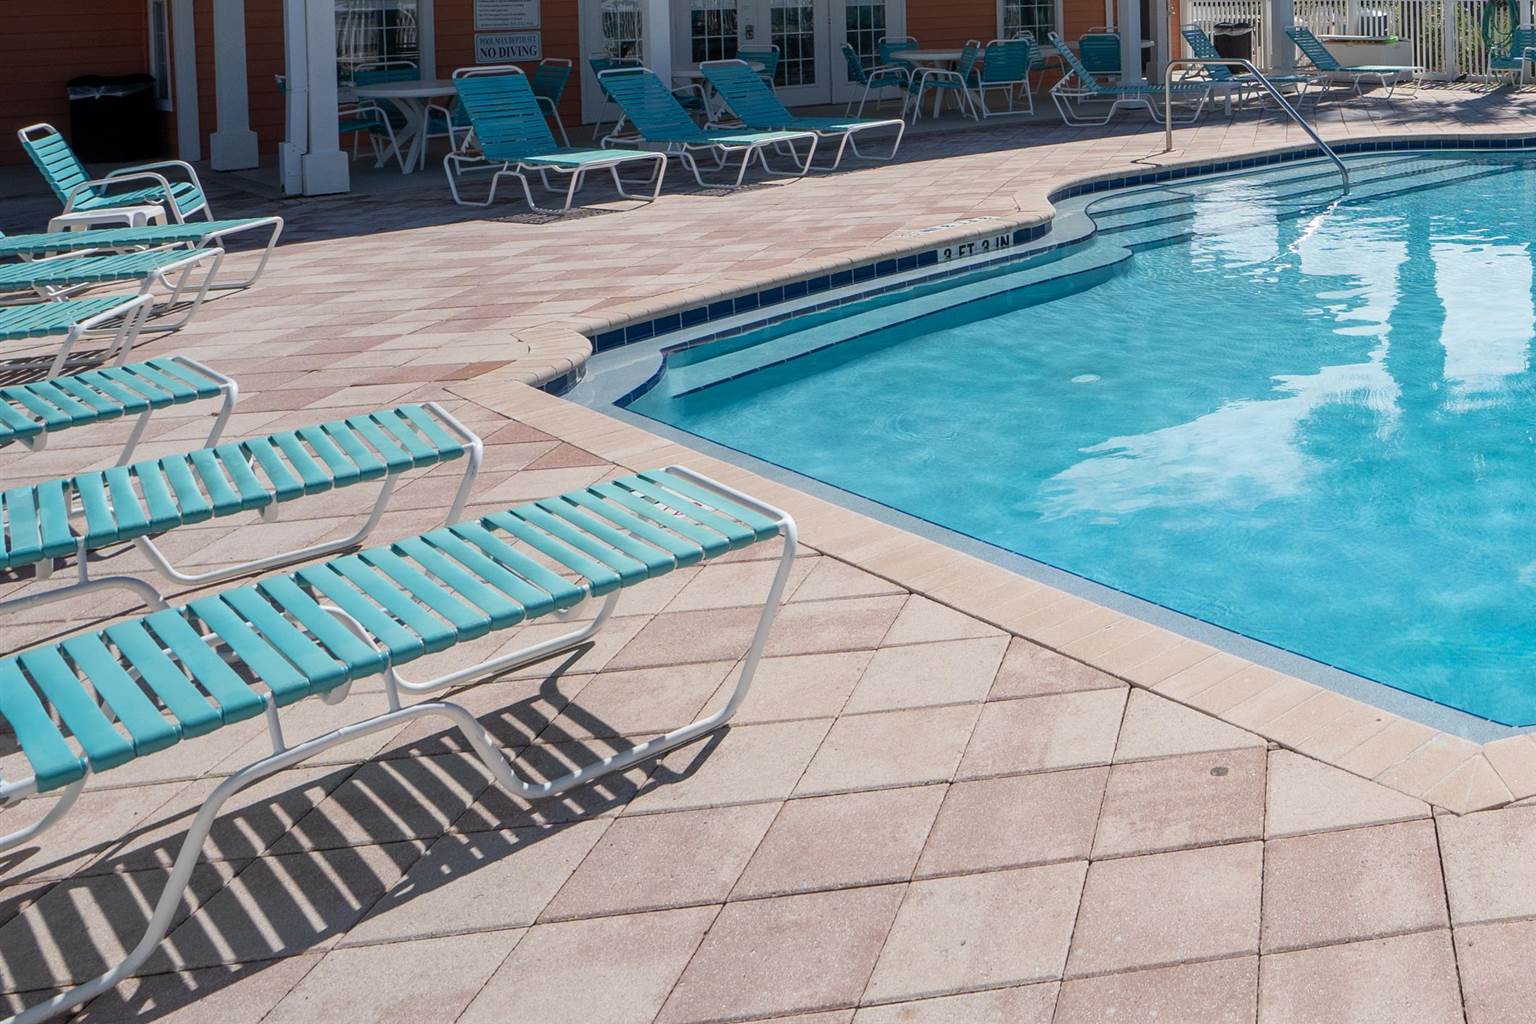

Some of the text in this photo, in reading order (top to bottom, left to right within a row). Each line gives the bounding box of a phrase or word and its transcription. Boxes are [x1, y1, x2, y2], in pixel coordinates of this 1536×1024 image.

[480, 45, 537, 58] NO DIVING
[958, 242, 975, 257] FT
[995, 234, 1010, 248] IN
